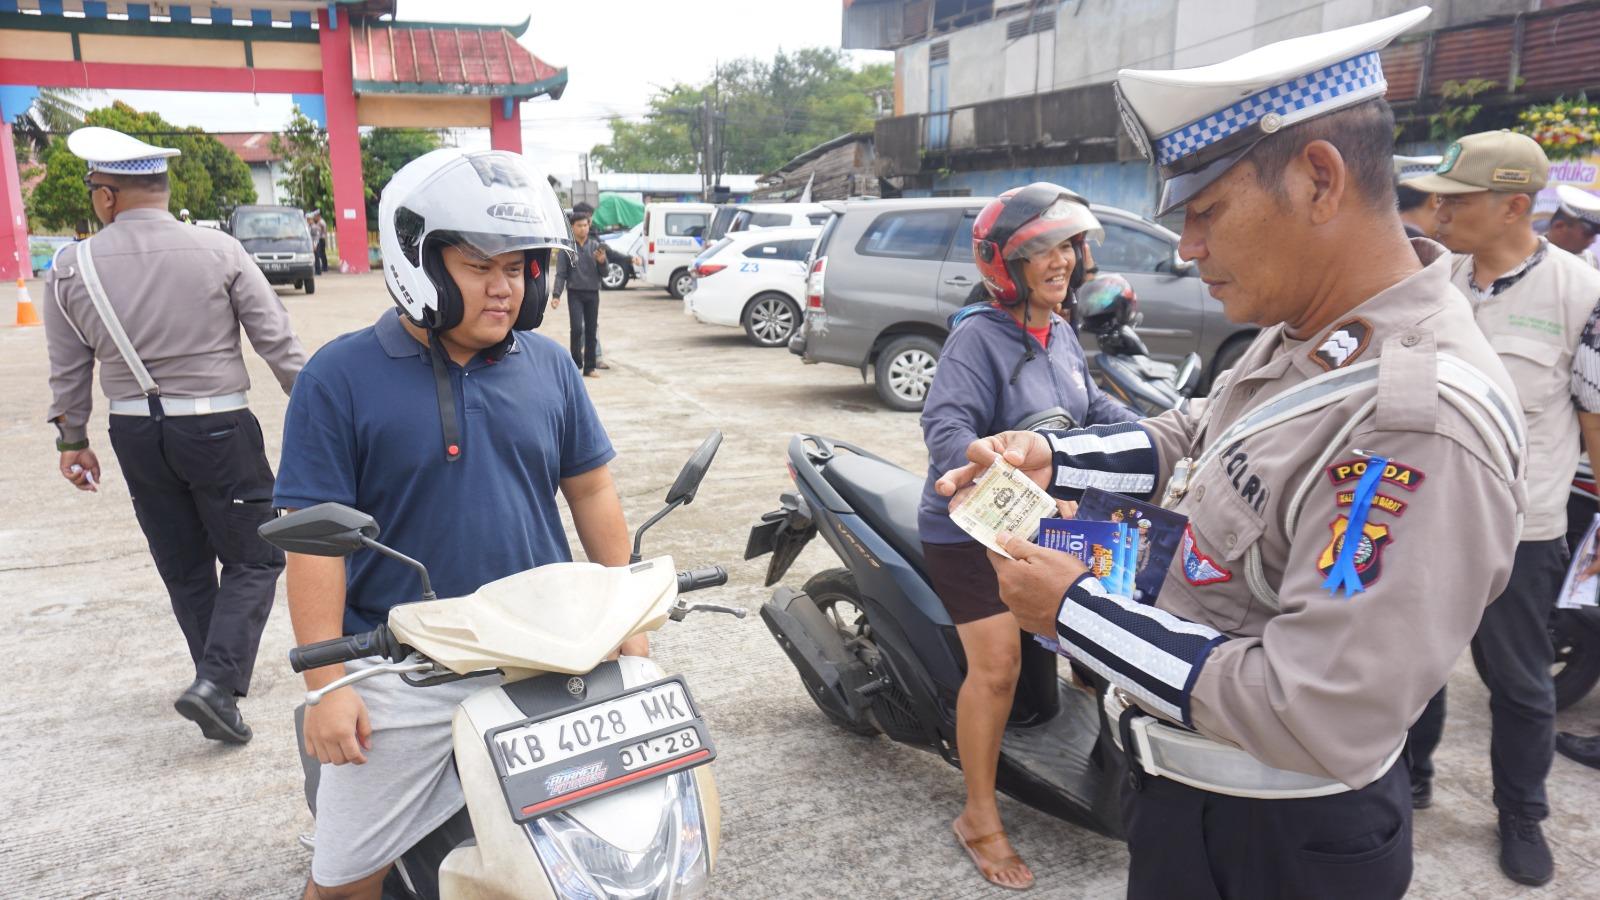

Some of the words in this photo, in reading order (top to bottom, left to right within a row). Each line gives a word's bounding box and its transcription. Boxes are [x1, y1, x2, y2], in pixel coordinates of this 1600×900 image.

[739, 261, 760, 273] Z3
[1337, 462, 1411, 485] PODA
[1070, 533, 1085, 551] 10
[501, 734, 546, 769] KB
[558, 709, 627, 751] 4028
[641, 691, 685, 724] MK
